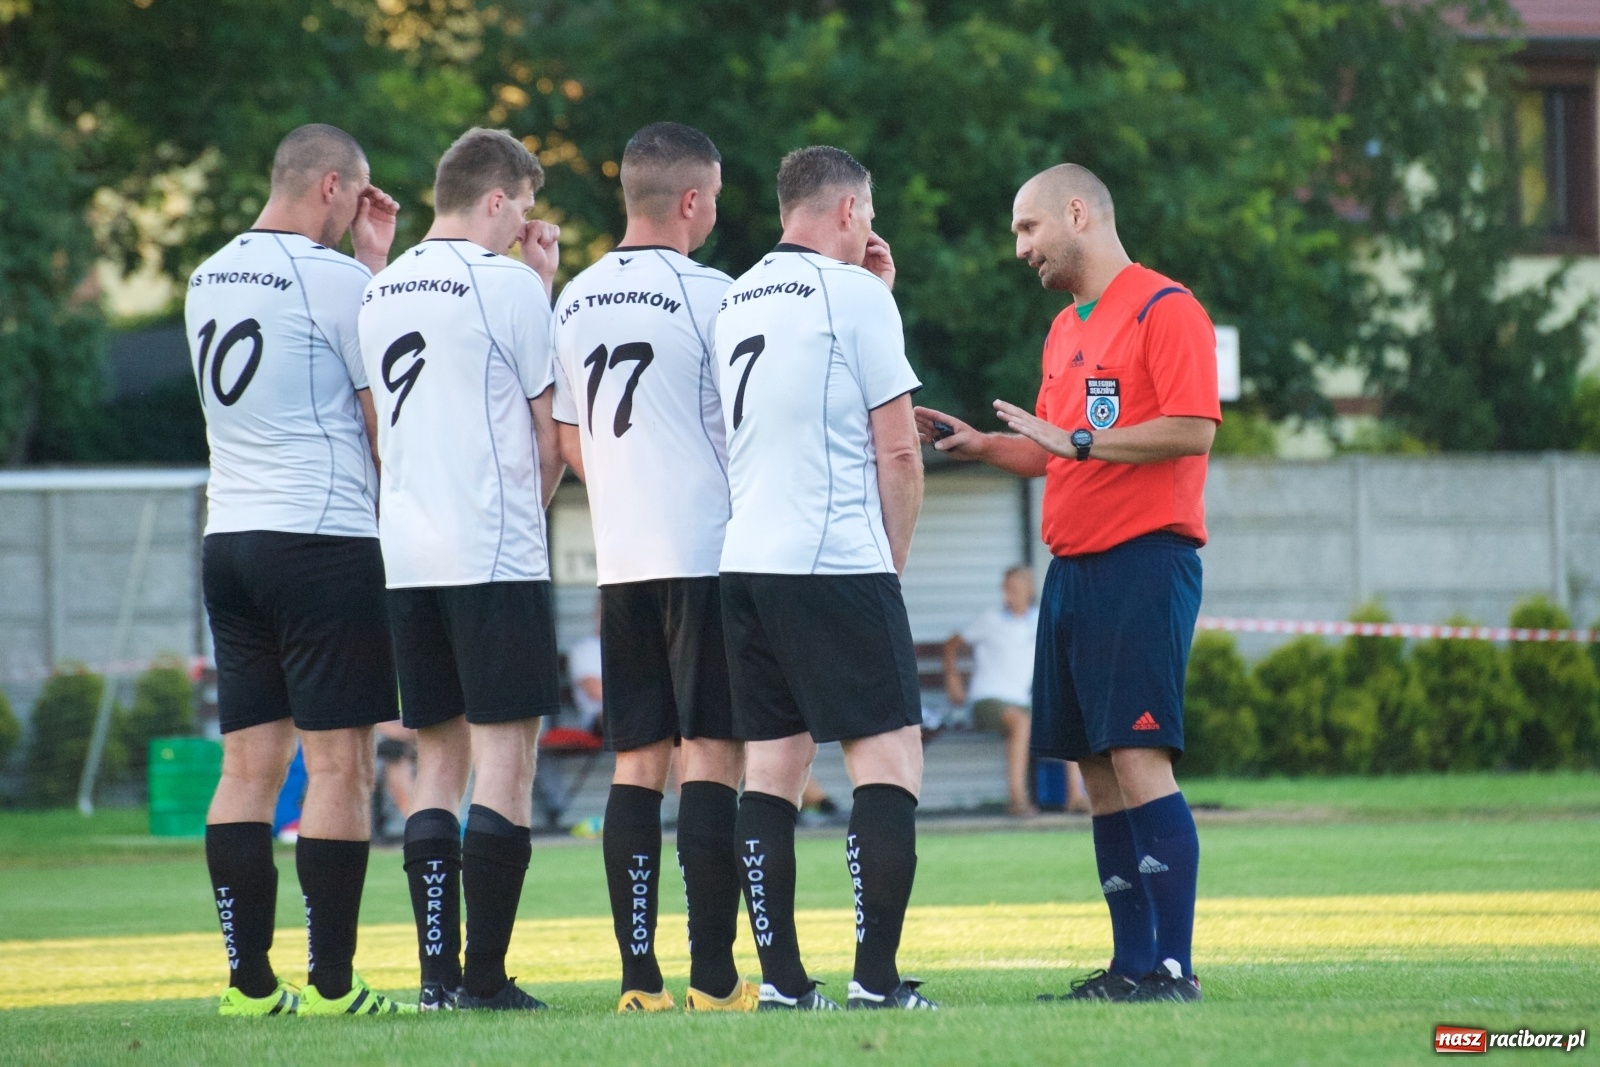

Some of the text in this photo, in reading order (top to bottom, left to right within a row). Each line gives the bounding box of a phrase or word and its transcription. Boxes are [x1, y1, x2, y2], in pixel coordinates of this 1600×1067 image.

[207, 272, 293, 291] TWORKÓW
[379, 278, 470, 297] TWORKÓW
[560, 291, 681, 325] LKS TWORKÓW
[733, 280, 816, 305] TWORKÓW
[198, 318, 263, 408] 10
[381, 331, 426, 428] 9
[584, 342, 654, 441] 17
[729, 334, 766, 431] 7
[1132, 723, 1160, 731] adidas
[217, 887, 240, 970] TWORKÓW
[423, 860, 447, 956] TWORKÓW
[628, 855, 651, 955] TWORKÓW
[743, 840, 773, 947] TWORKÓW
[847, 834, 866, 943] TWORKÓW
